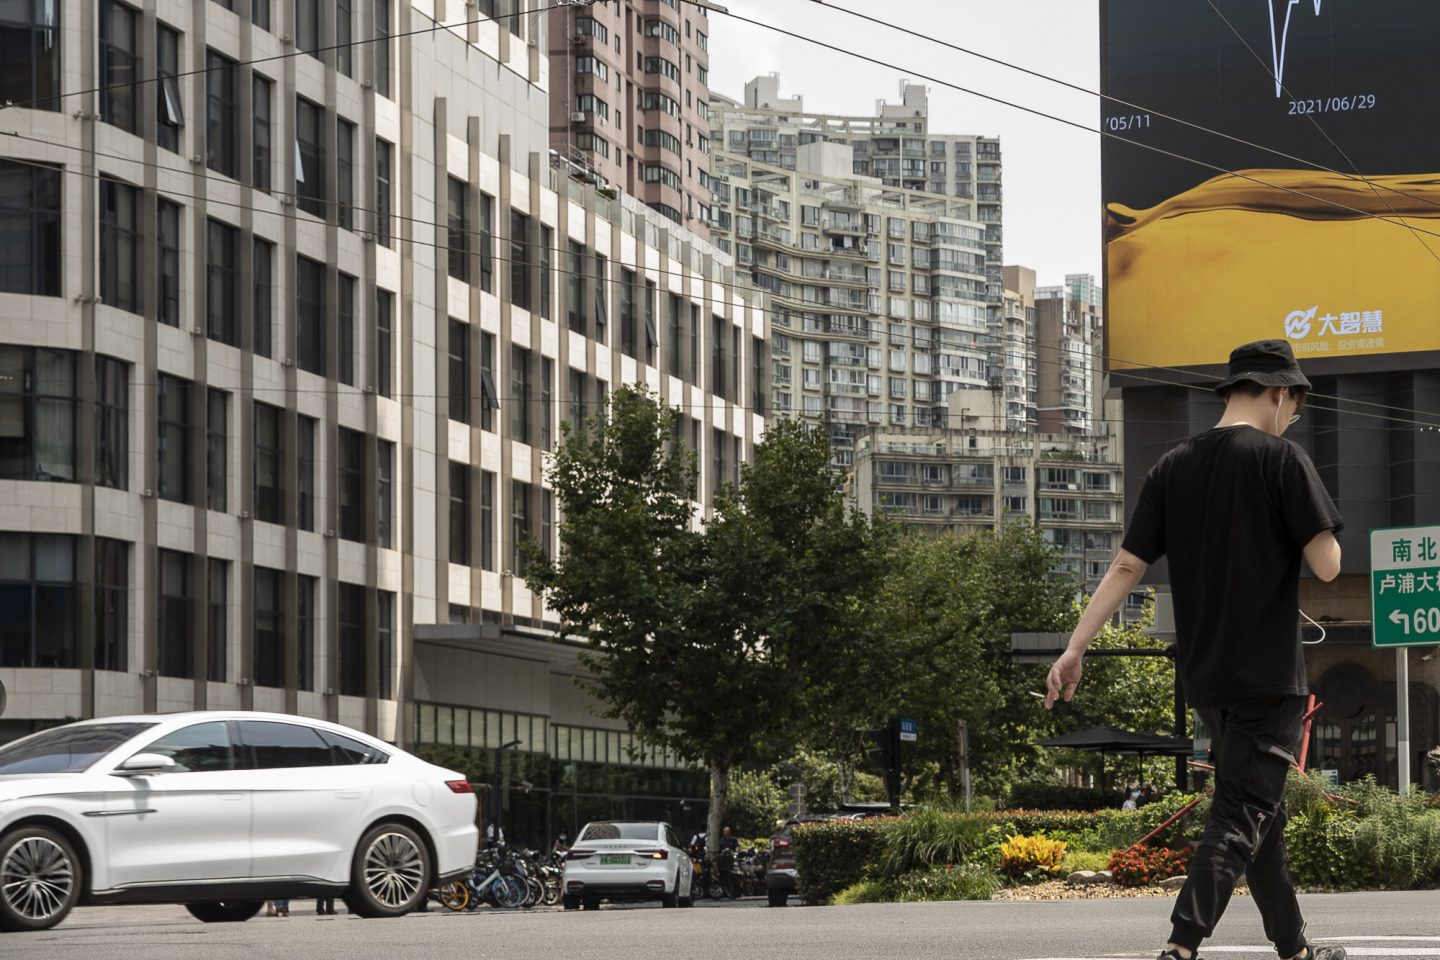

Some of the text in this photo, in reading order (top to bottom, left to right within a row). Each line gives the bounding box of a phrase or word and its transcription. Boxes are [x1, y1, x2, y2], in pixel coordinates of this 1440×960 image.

[1288, 94, 1376, 115] 2021/06/29
[1318, 310, 1383, 336] 大智慧
